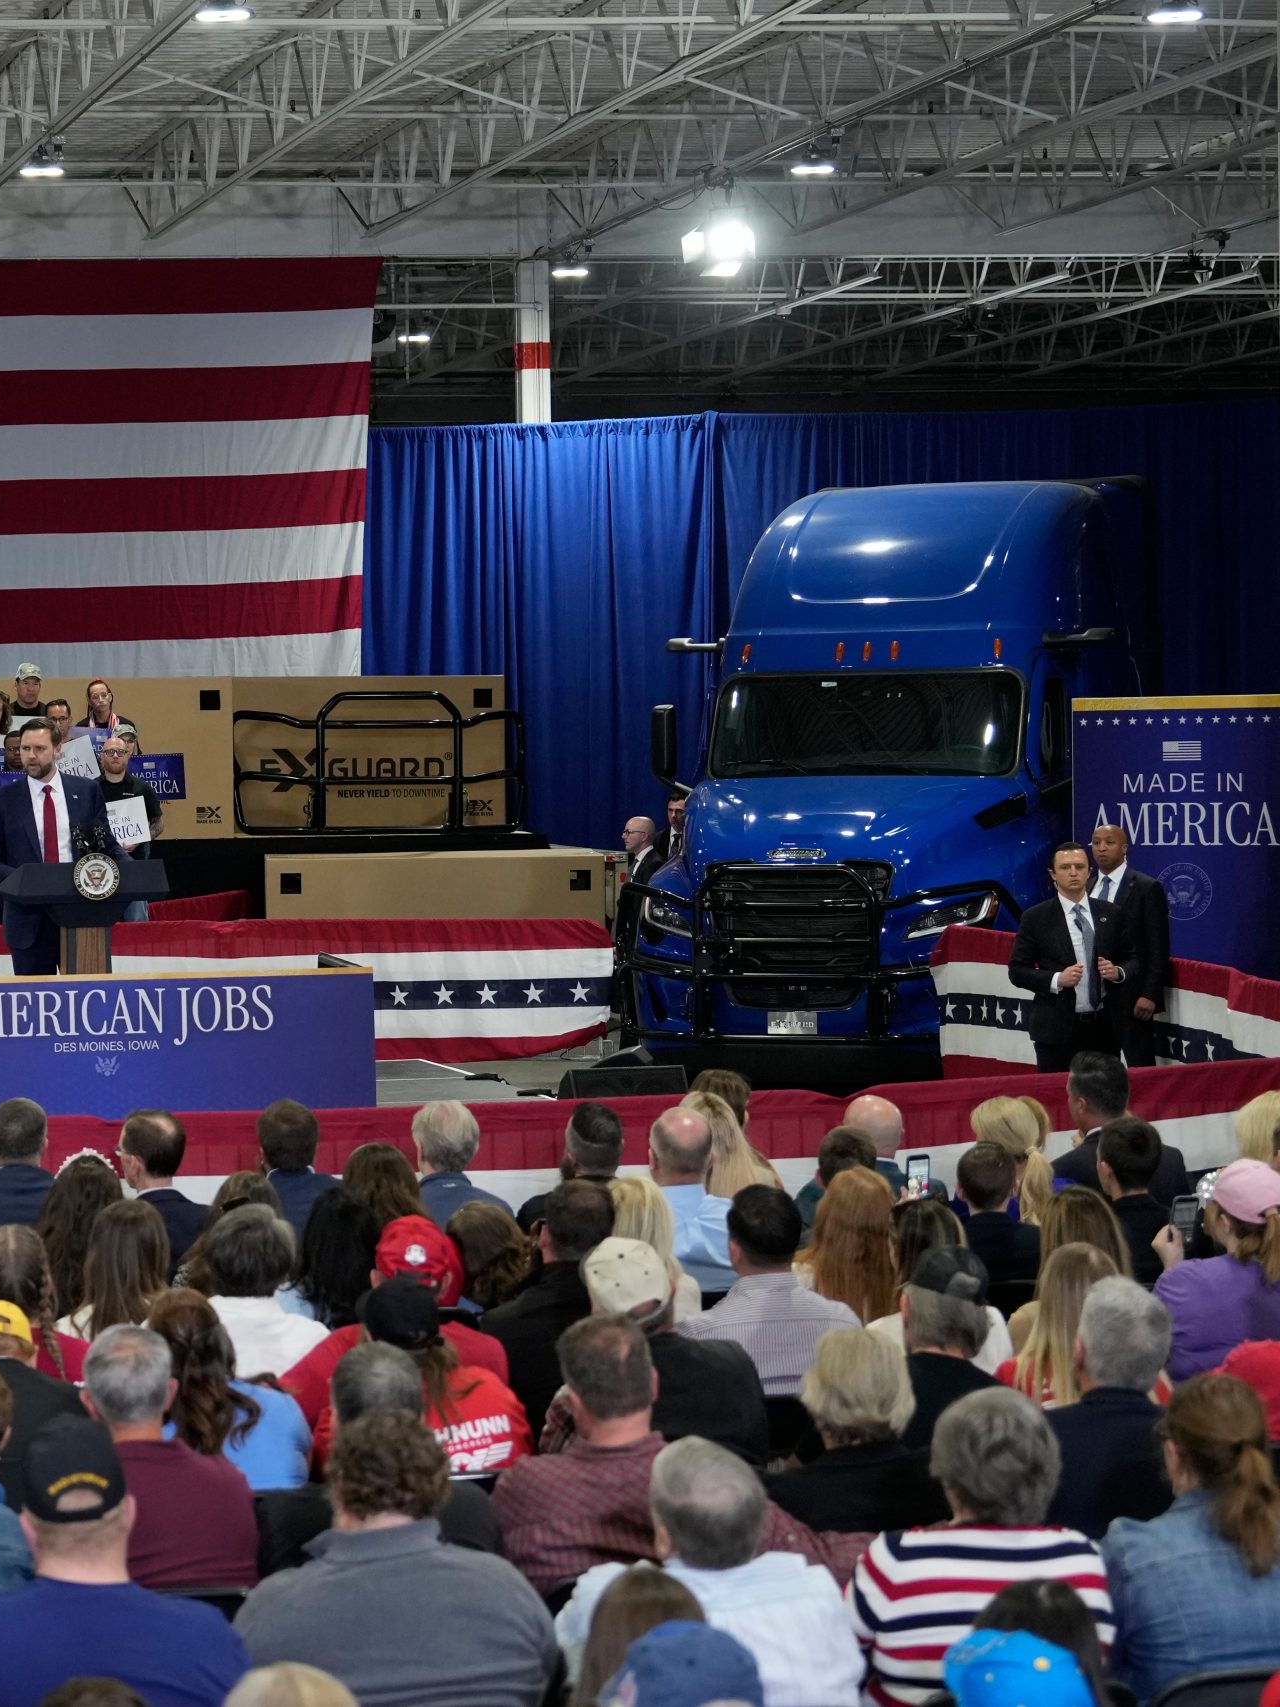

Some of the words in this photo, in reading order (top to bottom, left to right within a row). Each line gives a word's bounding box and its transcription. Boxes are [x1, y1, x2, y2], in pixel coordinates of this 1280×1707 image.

[151, 780, 180, 793] RICA
[1123, 773, 1205, 793] MADE
[1218, 773, 1243, 792] IN
[337, 788, 364, 798] NEVER
[367, 788, 390, 797] YIELD
[392, 789, 402, 797] TO
[404, 788, 445, 797] DOWNTIME
[113, 823, 143, 839] RICA
[1088, 801, 1280, 846] AMERICA
[174, 984, 275, 1046] JOBS
[54, 1042, 77, 1053] DES
[79, 1040, 127, 1053] MOINES,
[128, 1039, 160, 1051] IOWA
